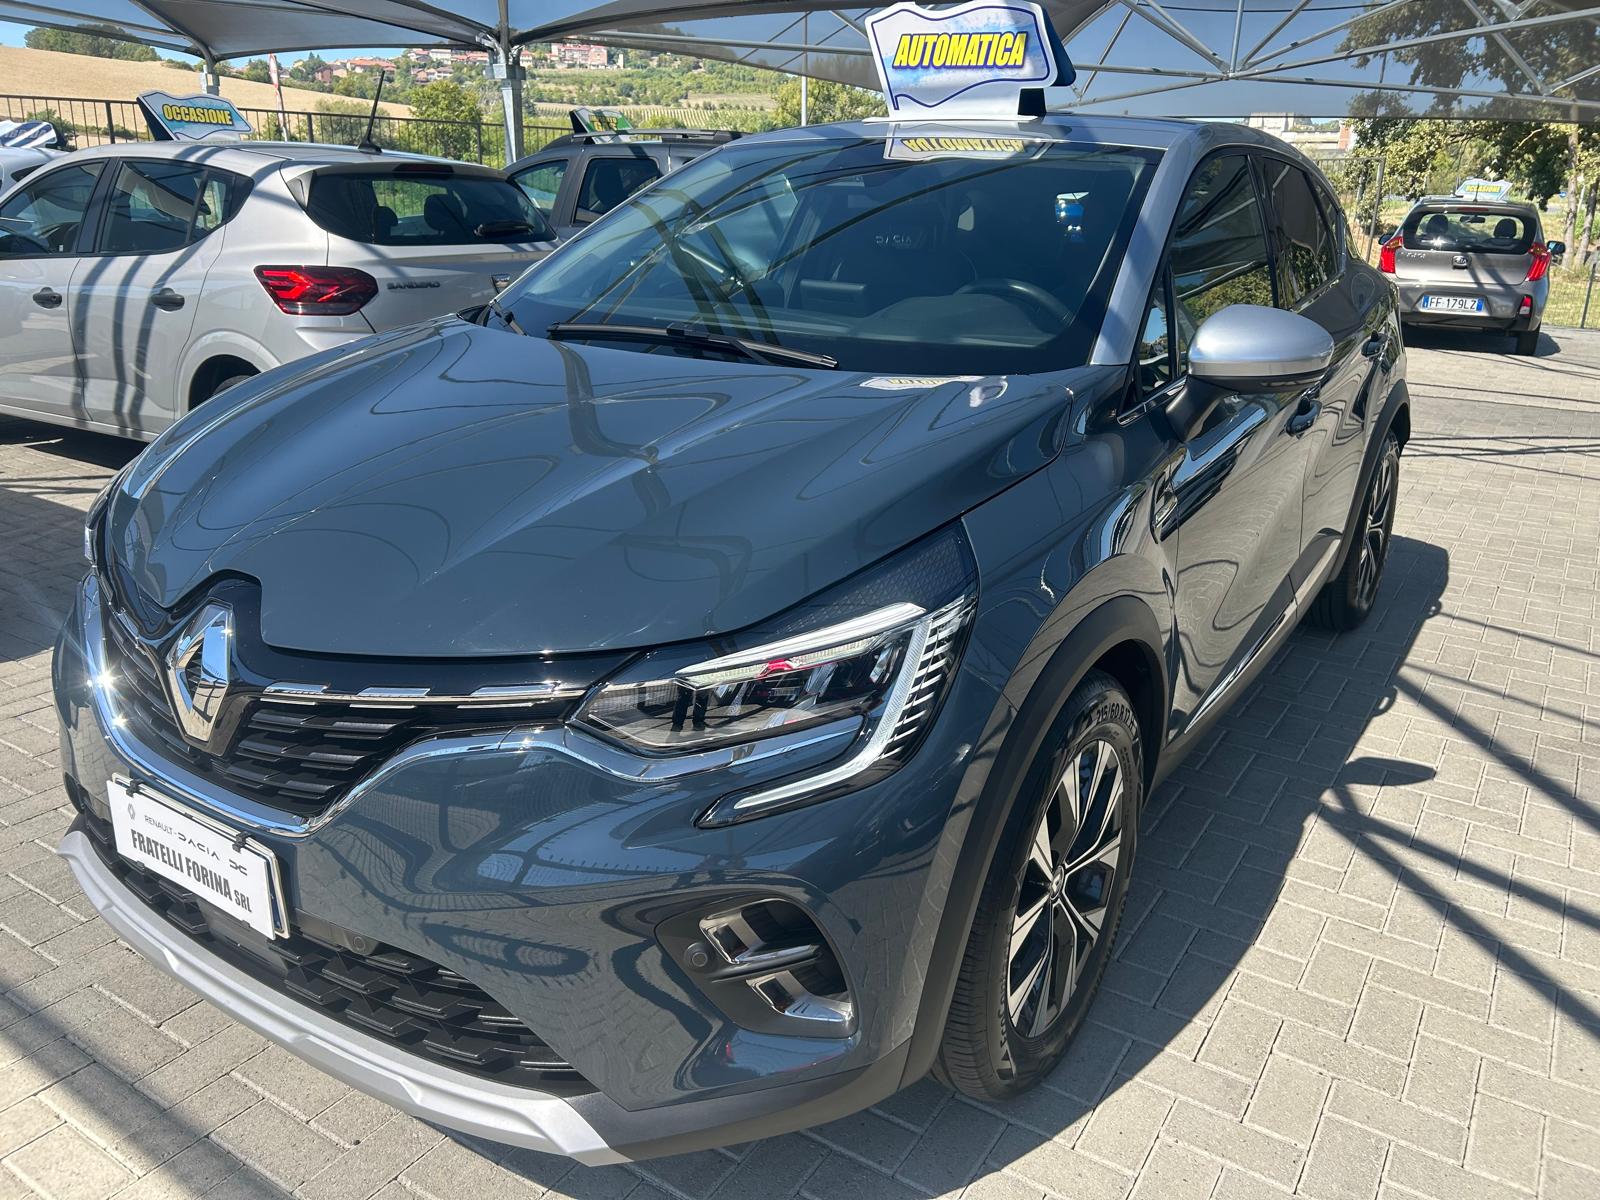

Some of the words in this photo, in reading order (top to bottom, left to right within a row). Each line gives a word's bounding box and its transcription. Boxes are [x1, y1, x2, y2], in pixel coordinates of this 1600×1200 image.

[892, 32, 1028, 68] AUTOMATICA
[162, 104, 234, 126] OCCASIONE
[387, 281, 440, 290] SANDERO
[144, 815, 174, 835] RENAULT
[178, 832, 220, 861] DACIA
[130, 828, 185, 874] FRATELLI
[185, 856, 233, 902] FORINA
[234, 889, 252, 913] SRL
